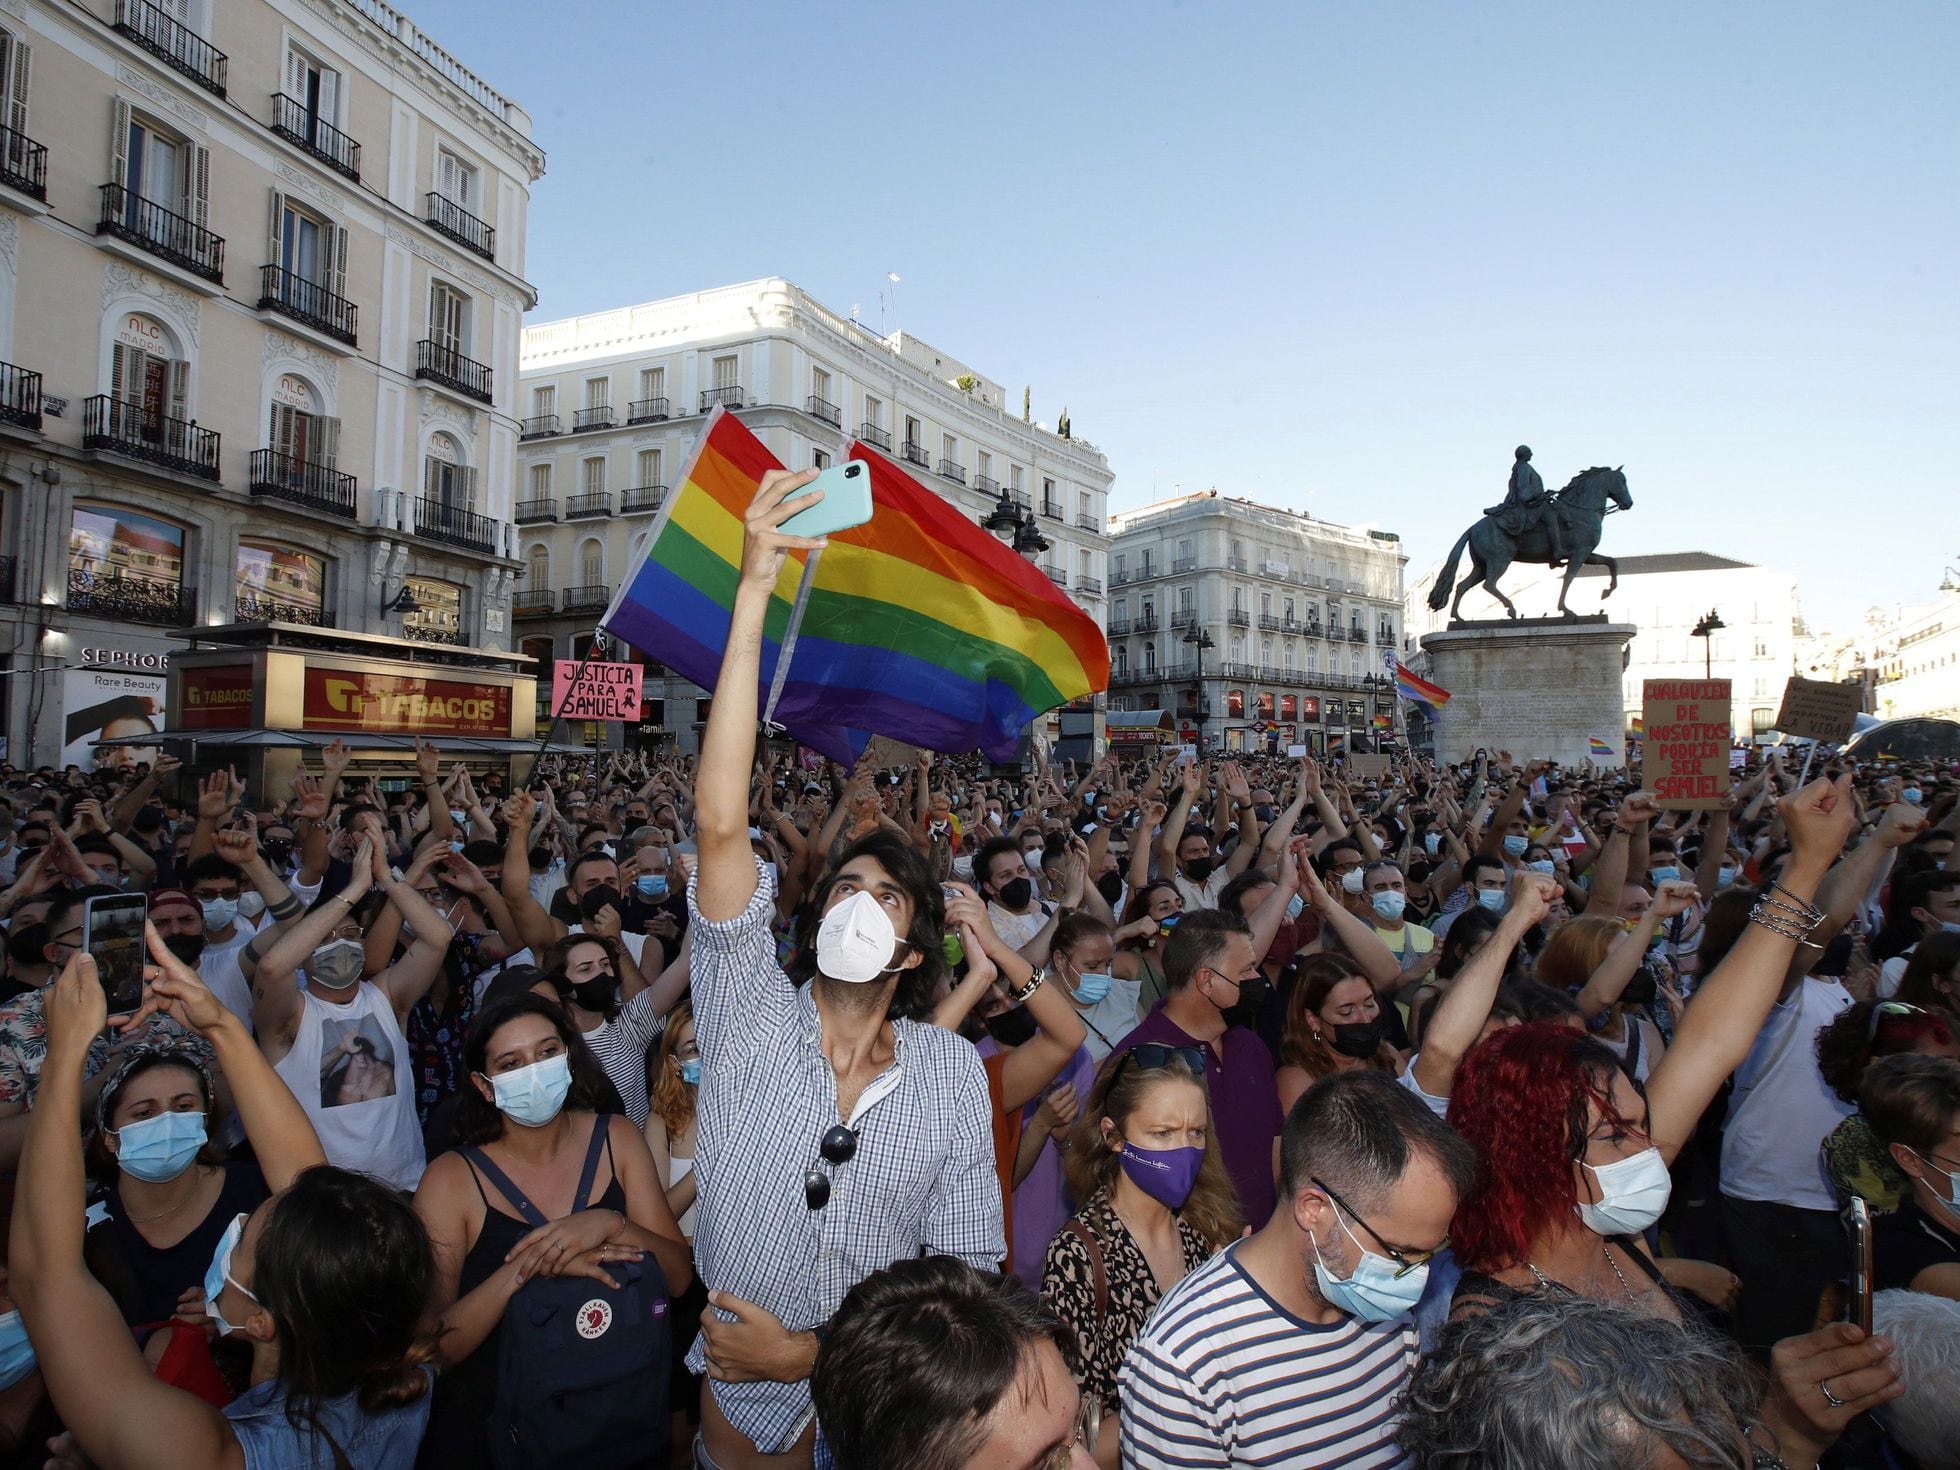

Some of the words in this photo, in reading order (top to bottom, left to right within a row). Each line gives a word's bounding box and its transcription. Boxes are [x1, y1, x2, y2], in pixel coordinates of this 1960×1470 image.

[120, 331, 166, 355] MADRID
[274, 391, 310, 410] MADRID
[427, 446, 454, 462] MADRID
[95, 675, 121, 687] Rare
[123, 677, 161, 692] Beauty
[563, 664, 634, 685] JUSTICIA
[204, 688, 253, 704] TABACOS
[578, 682, 616, 698] PARA
[375, 692, 496, 721] TABACOS
[563, 694, 626, 718] SAMUEL
[1676, 704, 1700, 721] DE
[1671, 760, 1703, 776] SER
[1653, 775, 1727, 800] SAMUEL
